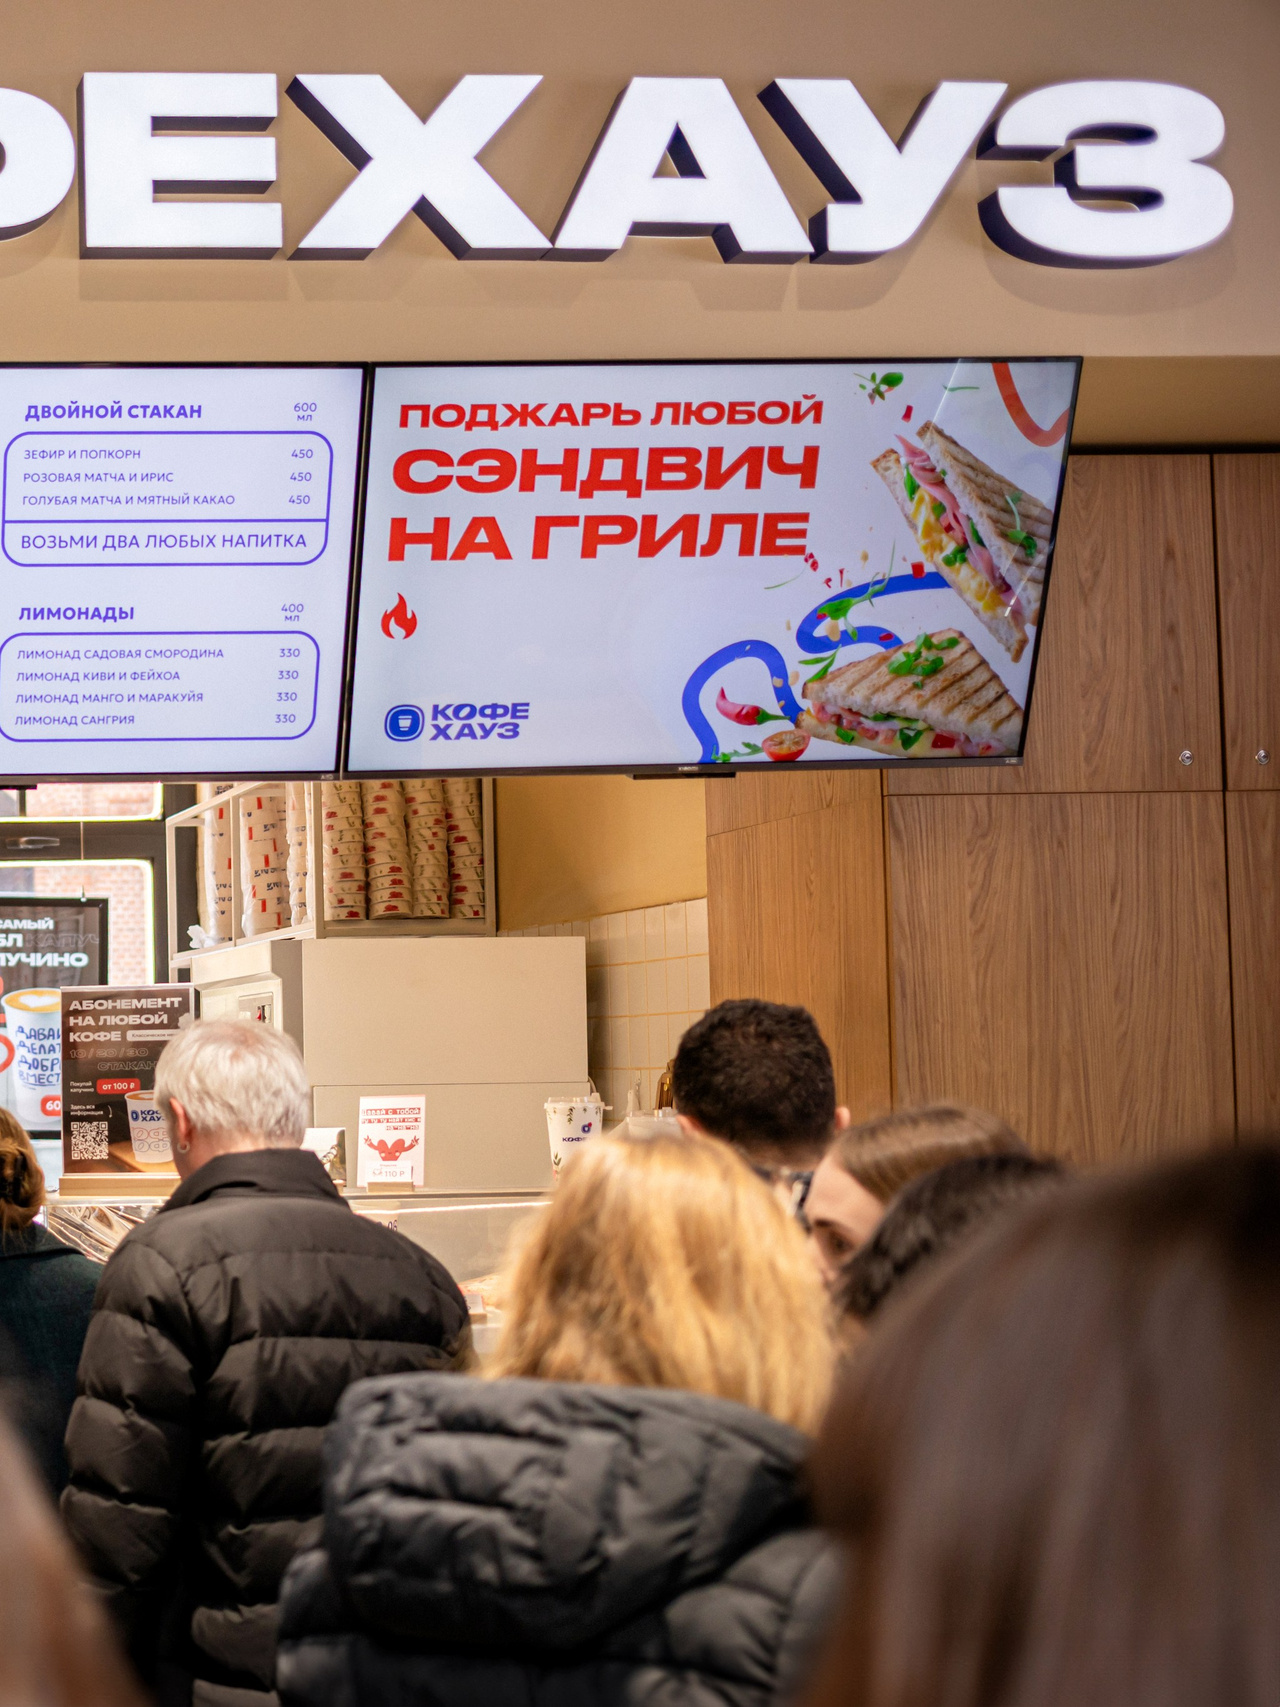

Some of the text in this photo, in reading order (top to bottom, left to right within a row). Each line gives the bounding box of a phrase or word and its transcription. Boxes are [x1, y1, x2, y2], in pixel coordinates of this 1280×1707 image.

[25, 400, 202, 422] ДВОЙНОЙ СТАКАН
[400, 395, 823, 431] ПОДЖАРЬ ЛЮБОЙ
[24, 449, 313, 459] ЗЕФИР И ПОПКОРН 450
[393, 446, 819, 499] СЭНДВИЧ
[22, 534, 306, 551] ВОЗЬМИ ДВА ЛЮБЫХ НАПИТКА
[389, 513, 809, 561] НА ГРИЛЕ
[19, 607, 134, 623] ЛИМОНАДЫ
[18, 649, 224, 660] ЛИМОНАД САДОВАЯ СМОРОДИНА
[432, 703, 530, 722] КОФЕ
[15, 716, 134, 726] ЛИМОНАД САНГРИЯ
[429, 723, 520, 741] ХАУЗ
[69, 997, 182, 1010] АБОНЕМЕНТ
[69, 1012, 168, 1026] НА ЛЮБОЙ
[69, 1031, 122, 1042] КОФЕ
[16, 1040, 61, 1054] ДЕЛАТ
[18, 1055, 60, 1072] ДОБР
[97, 1061, 156, 1071] СТАКАН
[19, 1071, 61, 1084] ВМЕСТ
[113, 1082, 128, 1090] 100
[46, 1100, 61, 1110] 60
